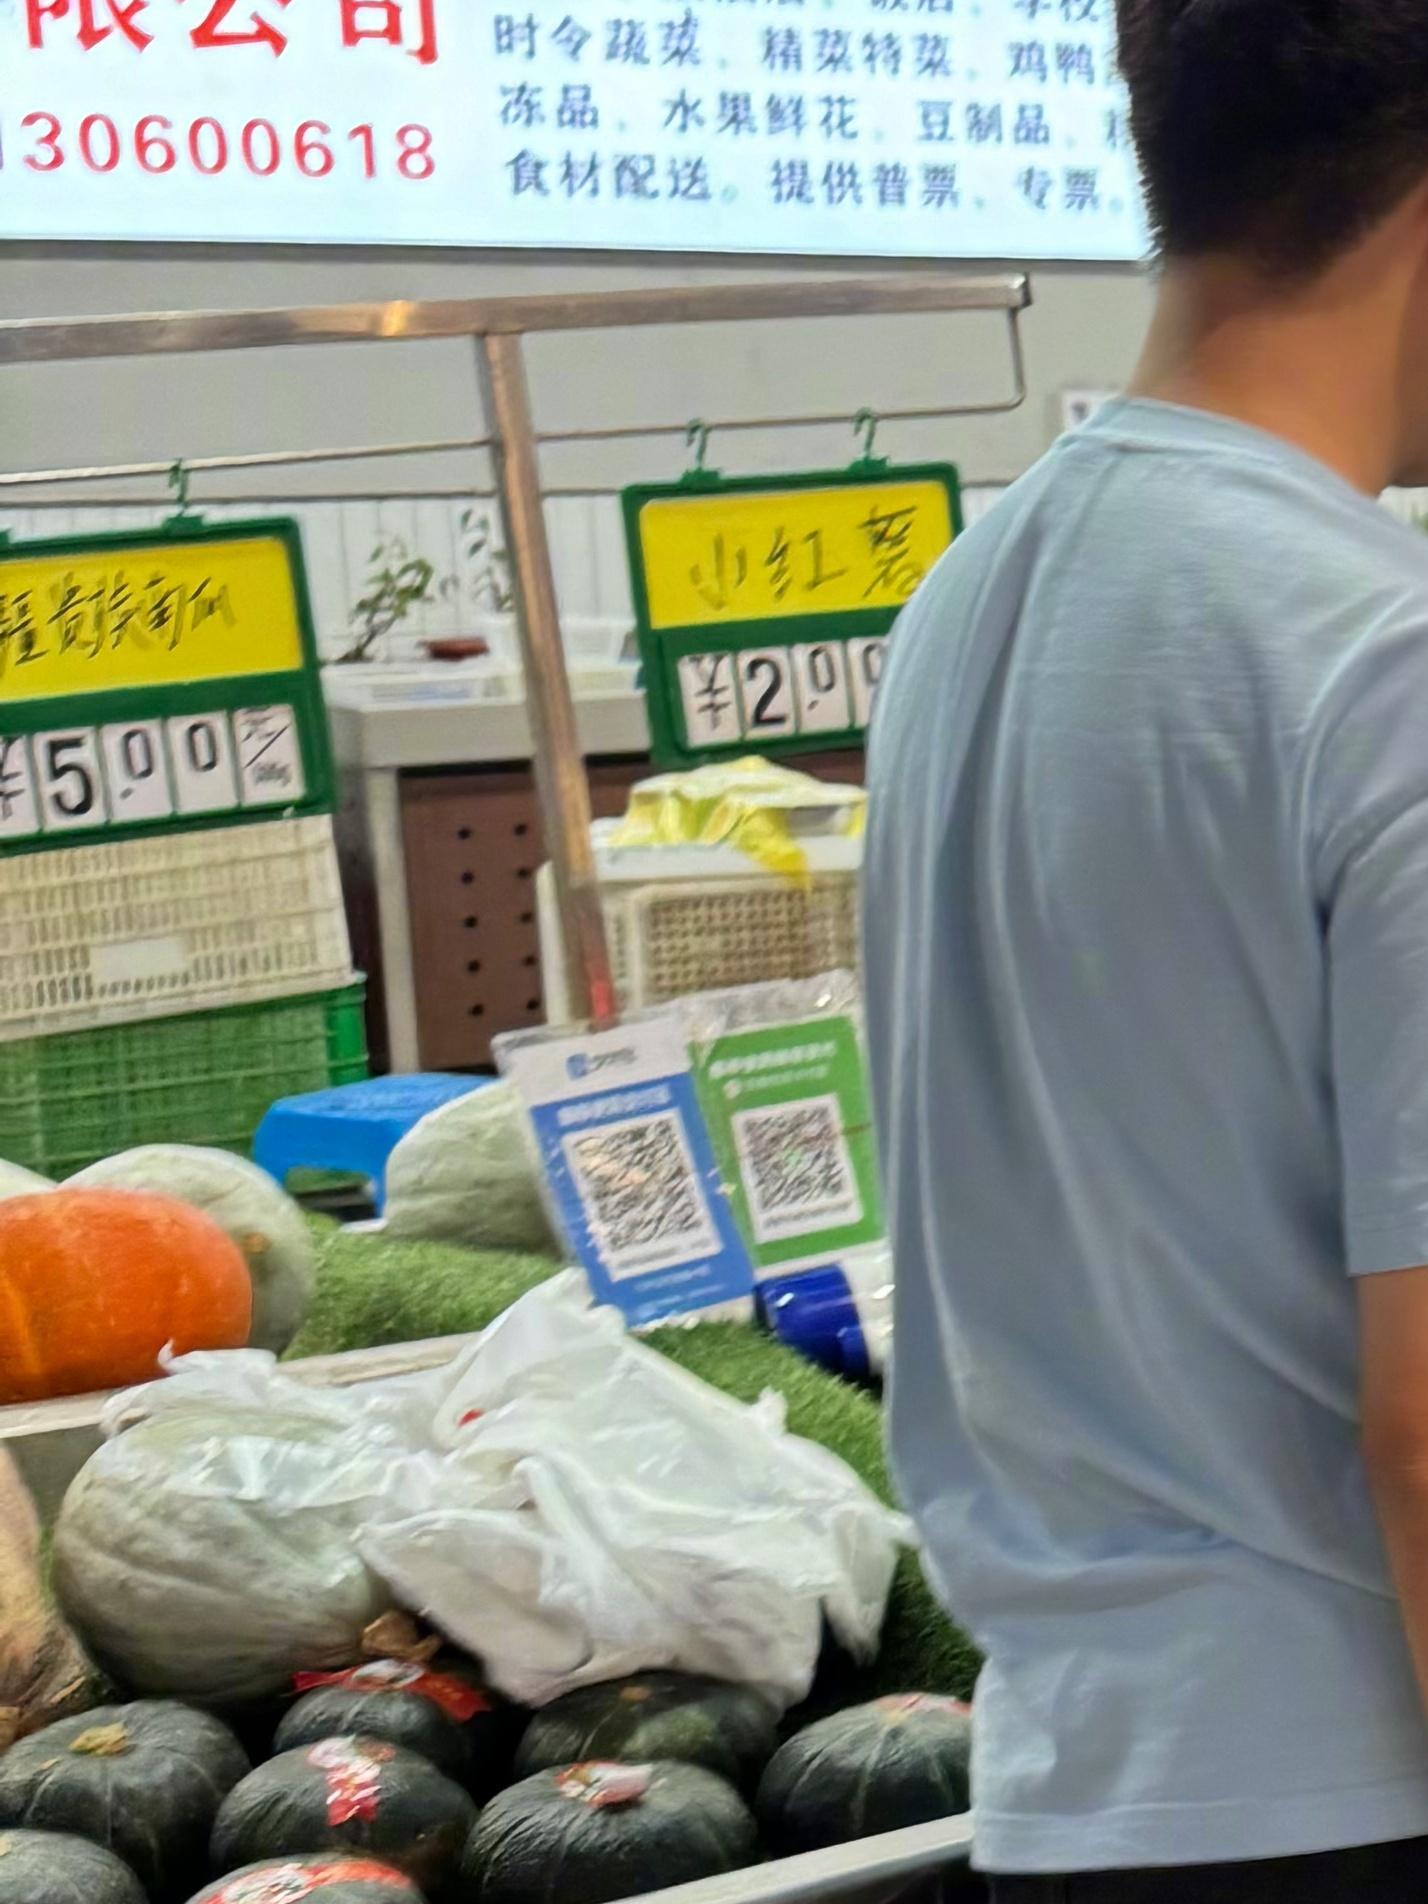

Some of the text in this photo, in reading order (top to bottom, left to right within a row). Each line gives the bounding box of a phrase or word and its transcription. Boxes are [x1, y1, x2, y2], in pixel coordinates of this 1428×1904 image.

[494, 12, 1122, 86] 时令蔬菜、精菜特菜、鸡鸭
[0, 110, 437, 180] 30600618
[689, 505, 924, 611] 小红薯
